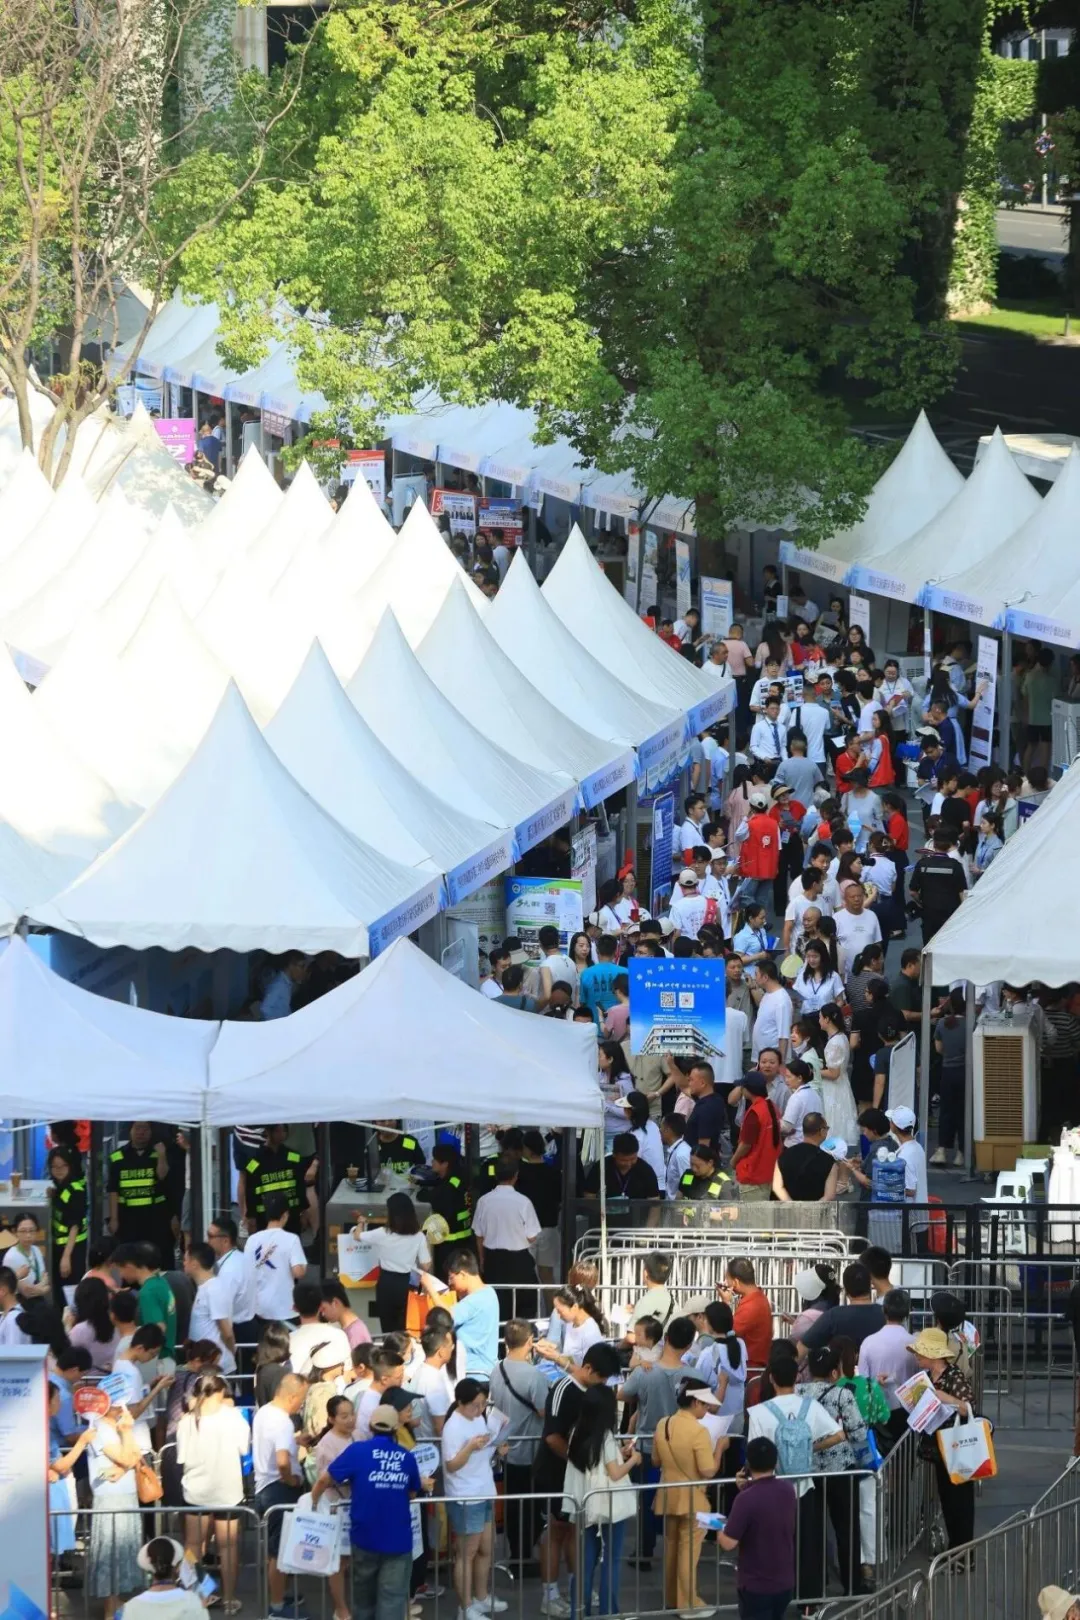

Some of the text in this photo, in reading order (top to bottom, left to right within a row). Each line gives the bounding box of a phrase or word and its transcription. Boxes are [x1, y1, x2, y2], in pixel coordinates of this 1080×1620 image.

[372, 1448, 406, 1461] ENJOY
[379, 1460, 402, 1471] THE
[368, 1470, 409, 1484] GROWTH
